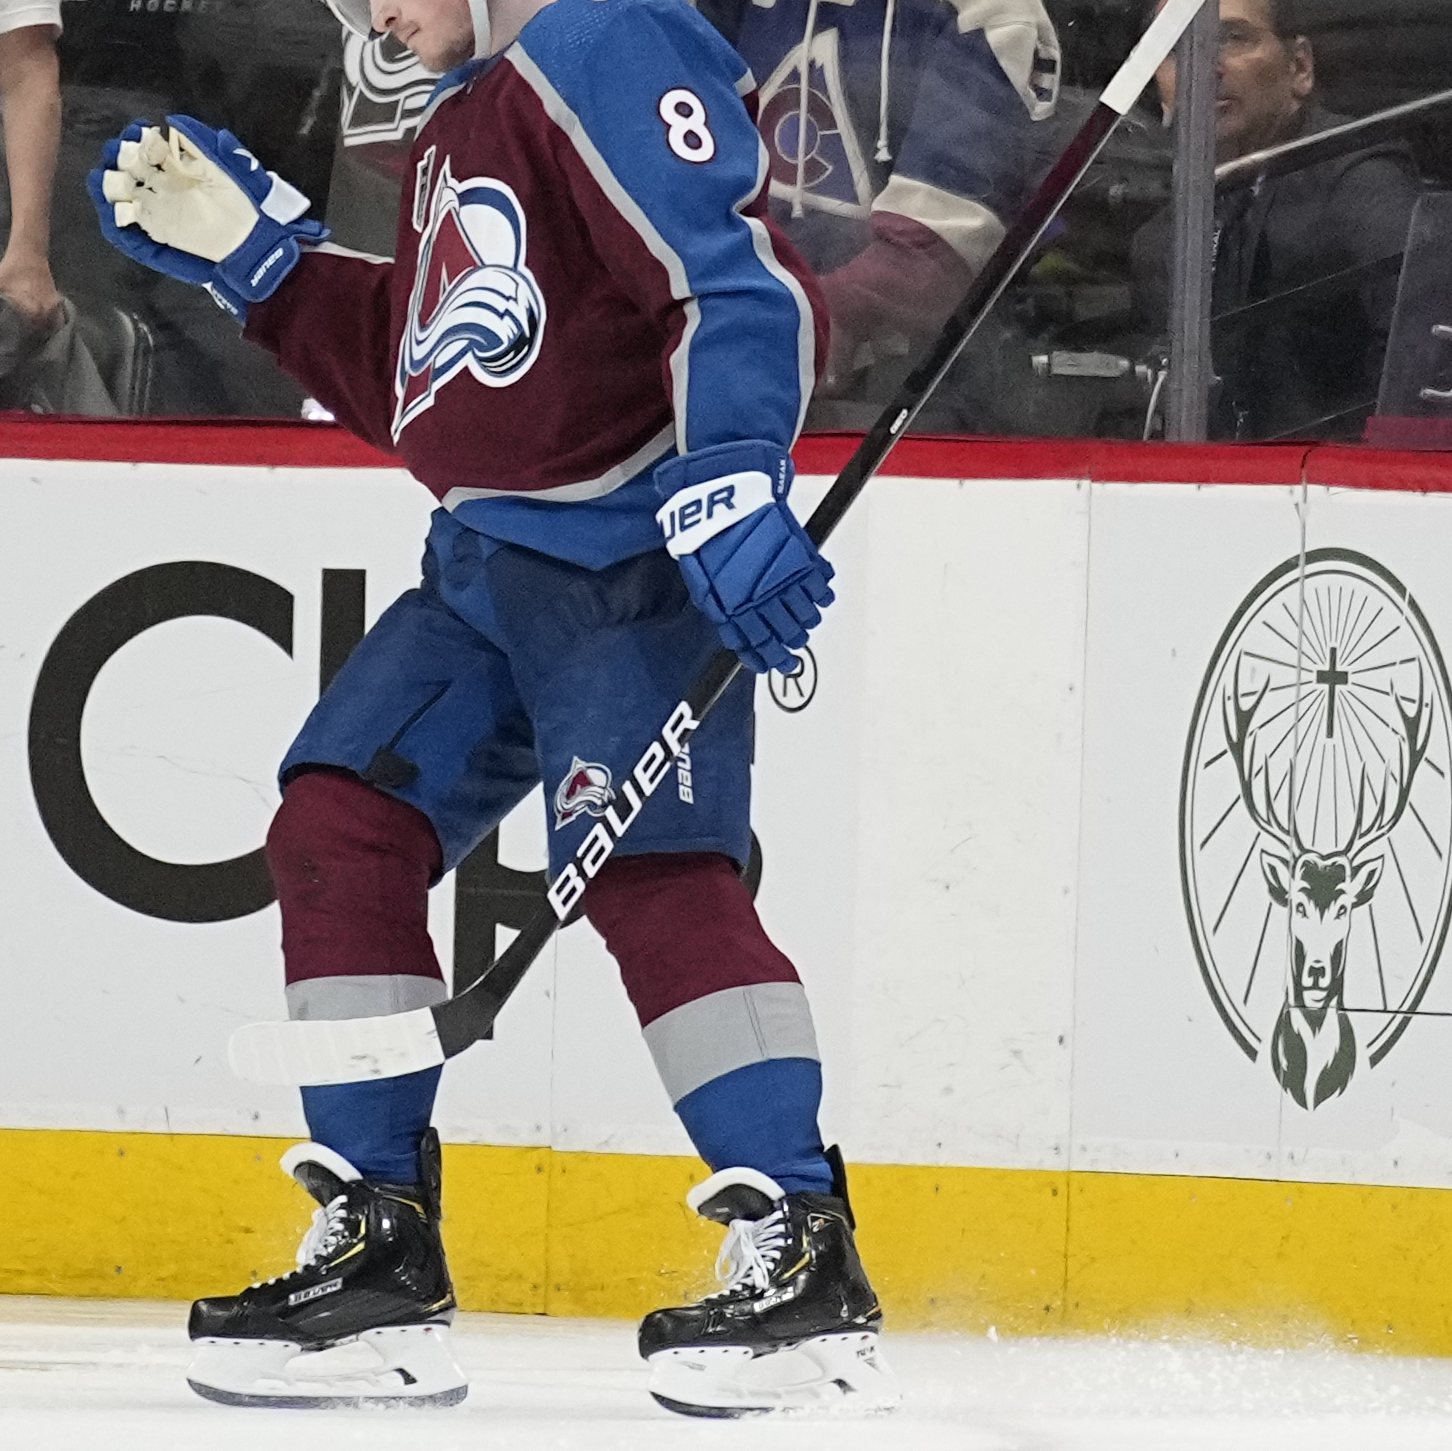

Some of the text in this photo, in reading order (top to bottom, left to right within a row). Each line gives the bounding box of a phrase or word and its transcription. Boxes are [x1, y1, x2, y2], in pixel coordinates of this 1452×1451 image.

[658, 87, 716, 164] 8
[547, 700, 701, 922] BAUER
[676, 742, 695, 805] BAU
